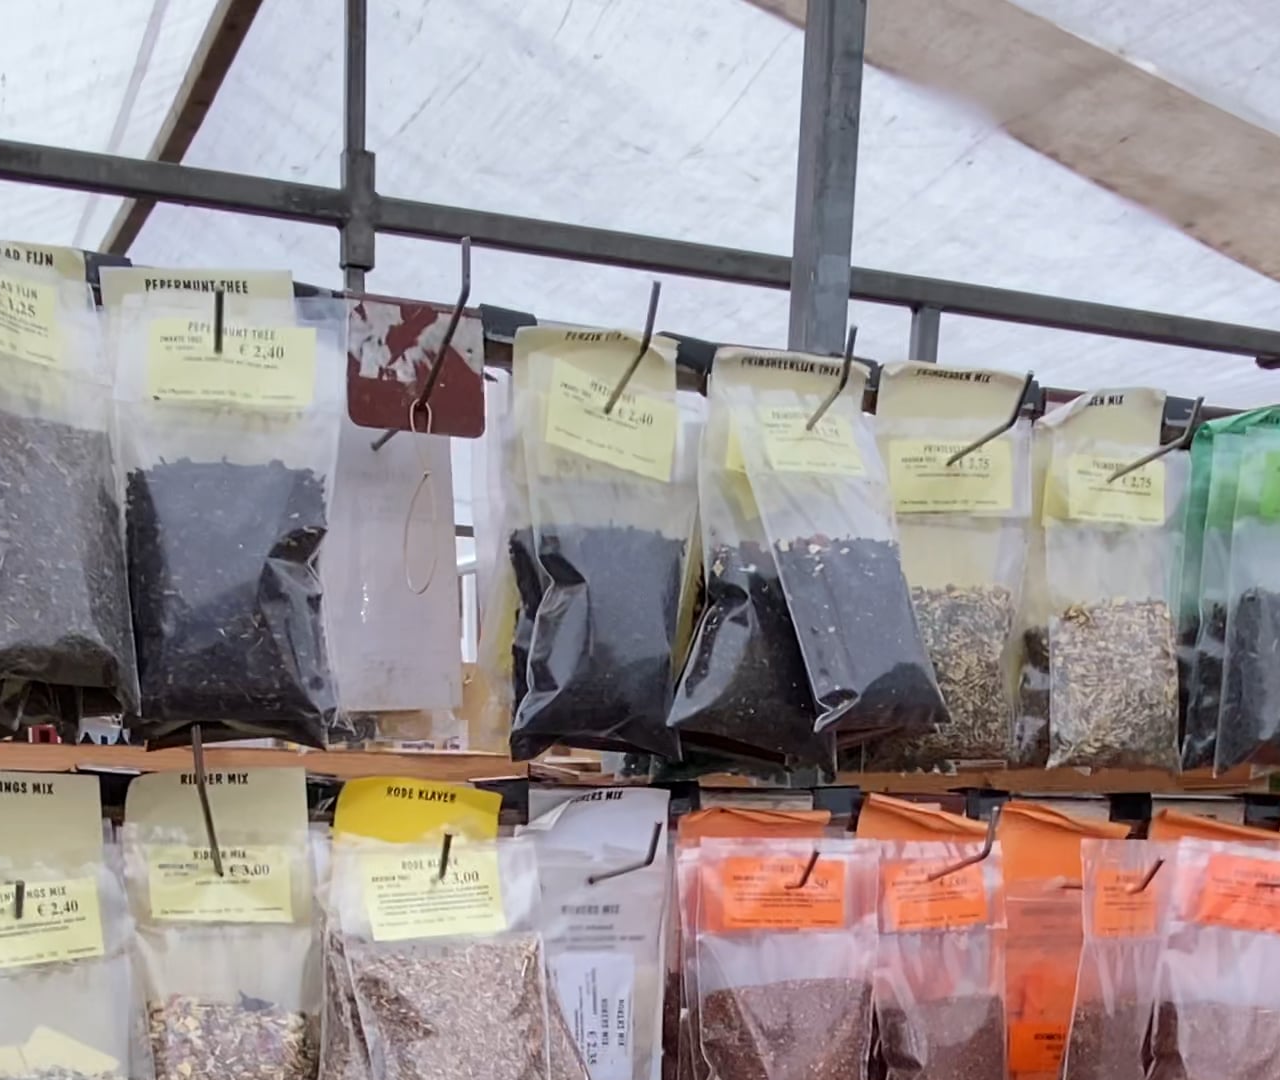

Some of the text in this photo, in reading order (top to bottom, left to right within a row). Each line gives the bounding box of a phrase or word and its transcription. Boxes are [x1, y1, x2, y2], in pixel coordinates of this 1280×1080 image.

[26, 251, 53, 266] FIJN
[18, 285, 38, 300] FIJN
[144, 279, 249, 294] PEPERMUNT THEE
[252, 330, 276, 341] THEE
[240, 345, 284, 359] € 2,40
[974, 370, 992, 383] MIX
[1109, 396, 1124, 405] MIX
[181, 773, 248, 784] RIER MIX
[32, 783, 53, 794] MIX
[386, 786, 456, 803] RODE KLAVER
[606, 791, 623, 800] MIX
[230, 864, 270, 876] € 3,00
[453, 871, 480, 885] 3,00
[50, 886, 66, 896] MIX
[37, 900, 78, 916] € 2,40
